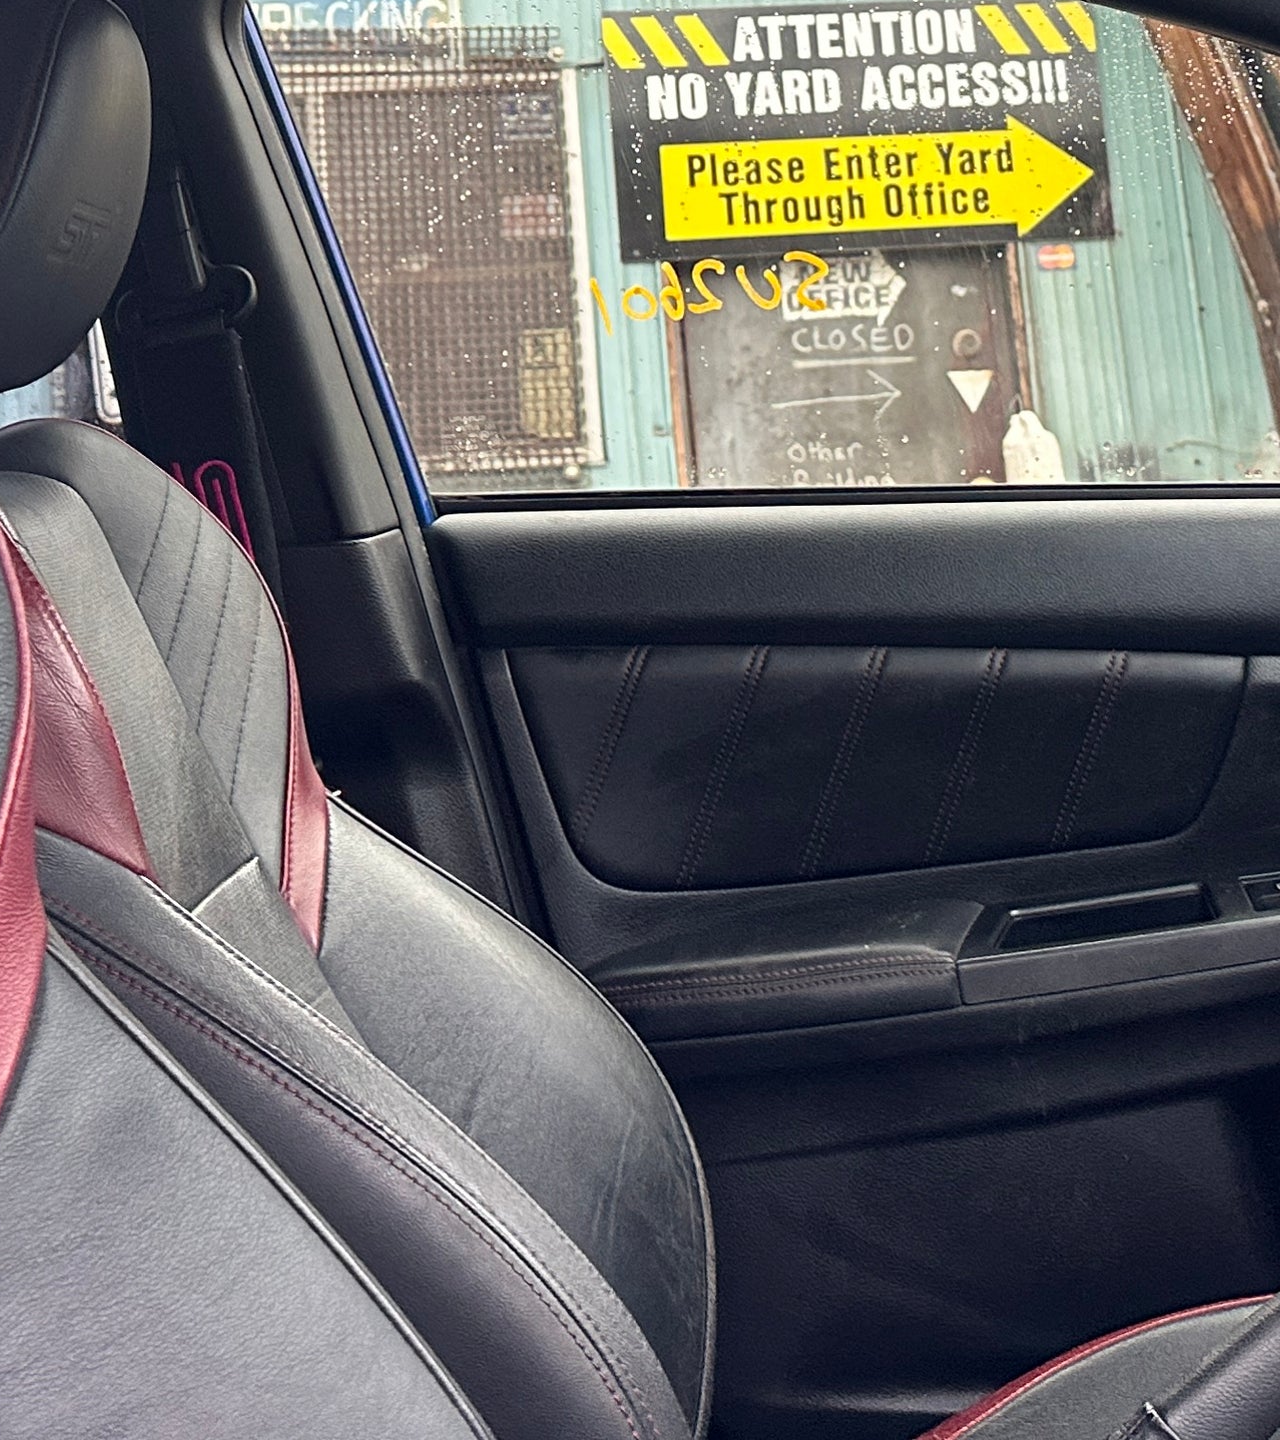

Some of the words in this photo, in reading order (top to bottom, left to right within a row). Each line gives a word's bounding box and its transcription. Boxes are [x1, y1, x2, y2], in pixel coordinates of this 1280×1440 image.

[732, 8, 977, 62] ATTENTION
[646, 74, 709, 120] NO
[728, 68, 841, 117] YARD
[861, 60, 1070, 112] ACCESS!!!
[687, 153, 805, 188] Please
[824, 145, 919, 182] Enter
[936, 141, 1015, 176] Yard
[719, 188, 866, 227] Through
[884, 182, 991, 219] Office
[791, 323, 915, 353] CLOSED
